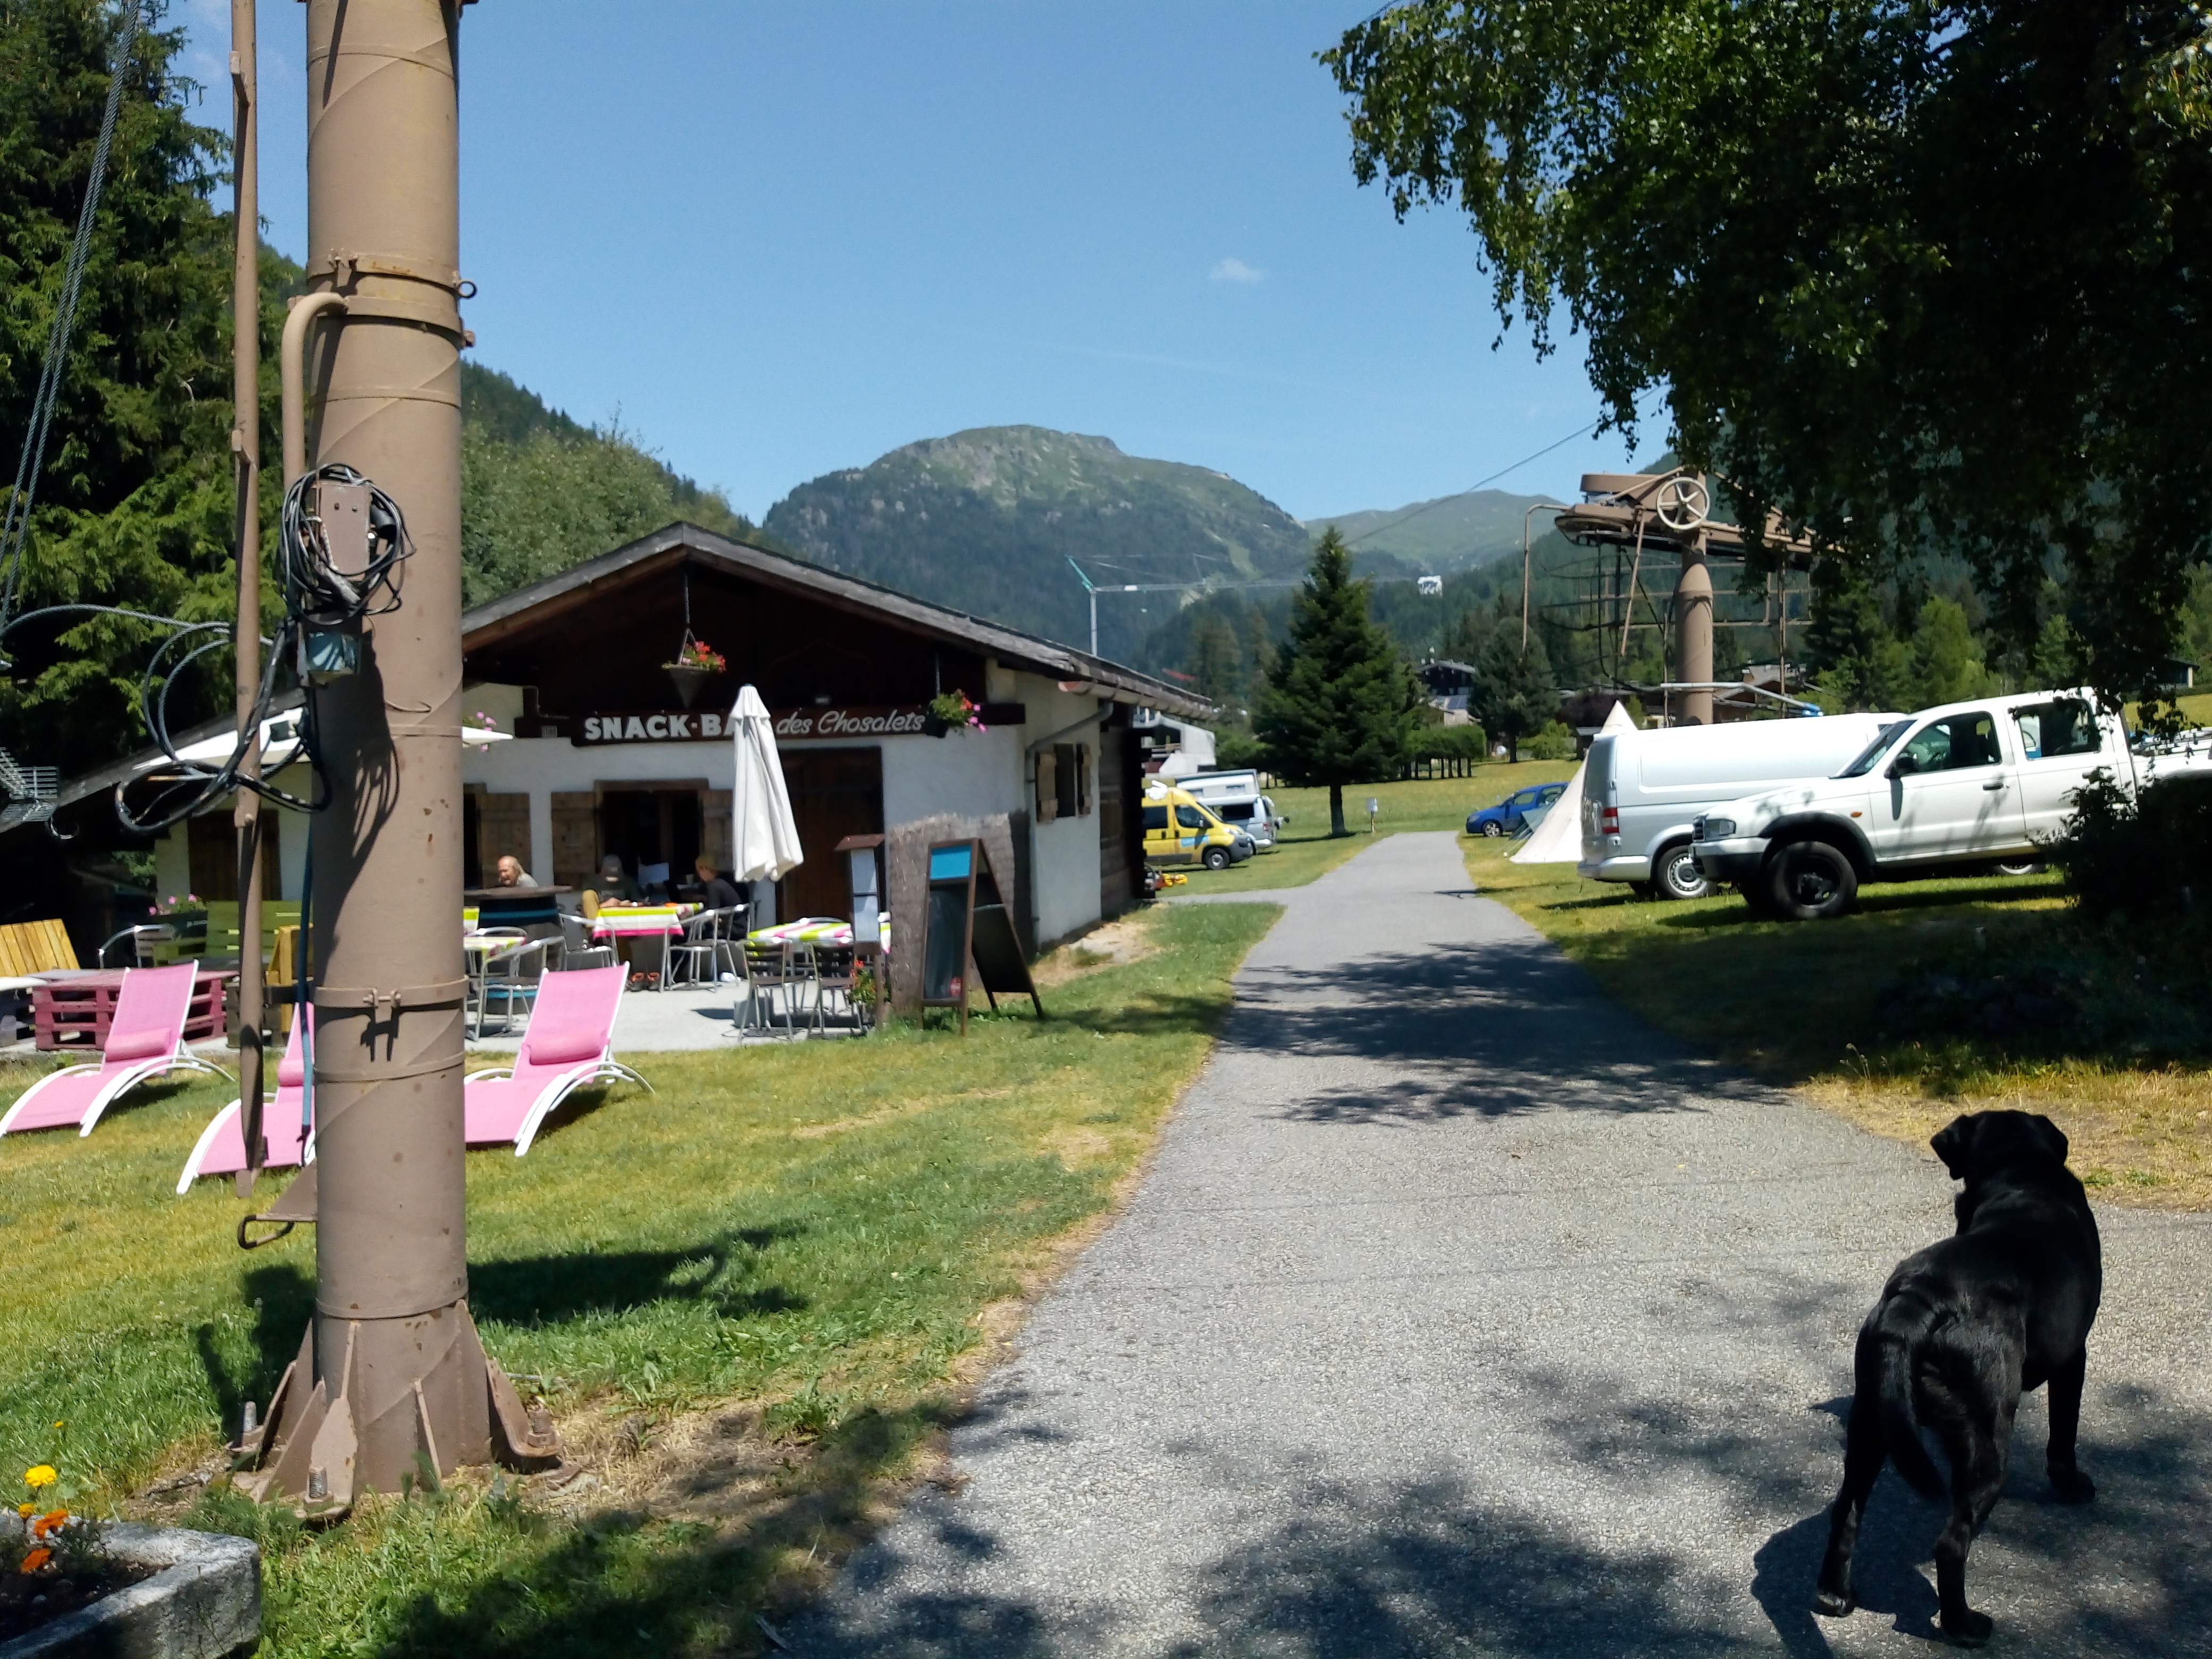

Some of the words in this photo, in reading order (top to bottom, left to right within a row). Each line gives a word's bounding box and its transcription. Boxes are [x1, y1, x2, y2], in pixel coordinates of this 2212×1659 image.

[585, 713, 735, 740] SNACK-B
[776, 711, 812, 734] des
[818, 709, 926, 734] Chosalets
